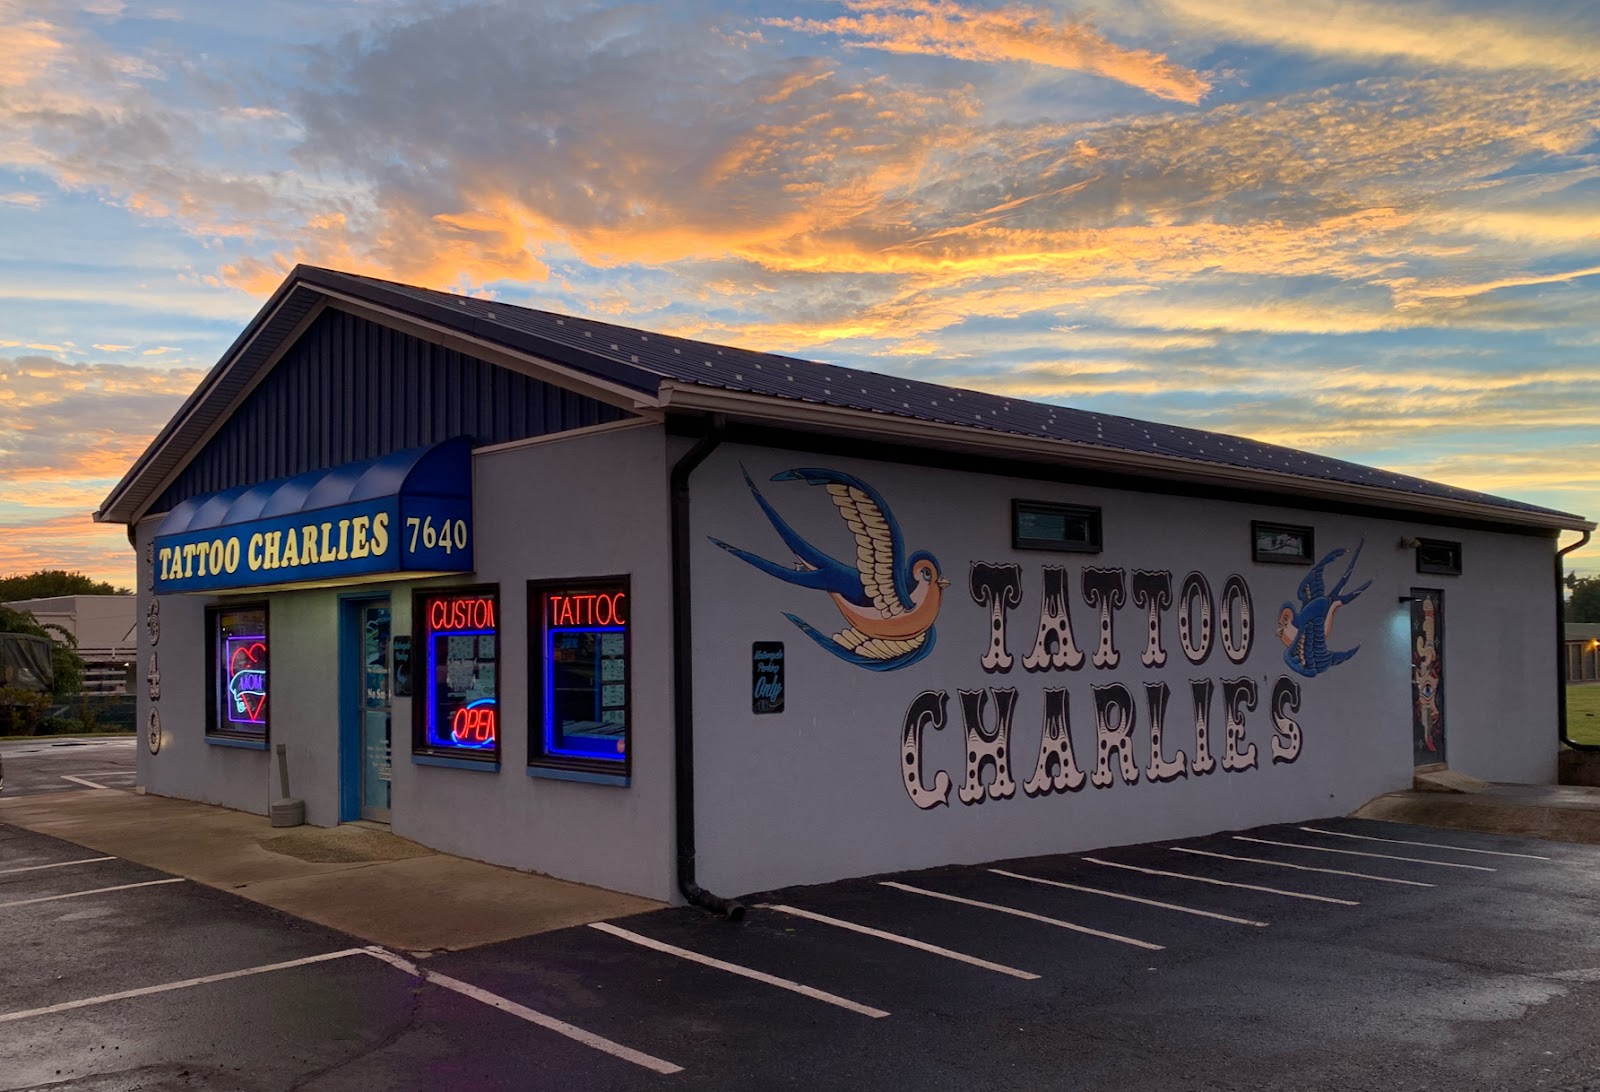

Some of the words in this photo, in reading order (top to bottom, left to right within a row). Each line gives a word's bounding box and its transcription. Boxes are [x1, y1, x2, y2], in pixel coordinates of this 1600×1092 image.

[159, 535, 241, 581] TATTOO
[247, 511, 389, 572] CHARLIES
[406, 515, 468, 555] 7640
[968, 560, 1256, 675] TATTOO
[240, 674, 263, 691] MOM
[755, 674, 782, 702] Only
[901, 674, 1304, 811] CHARLIES
